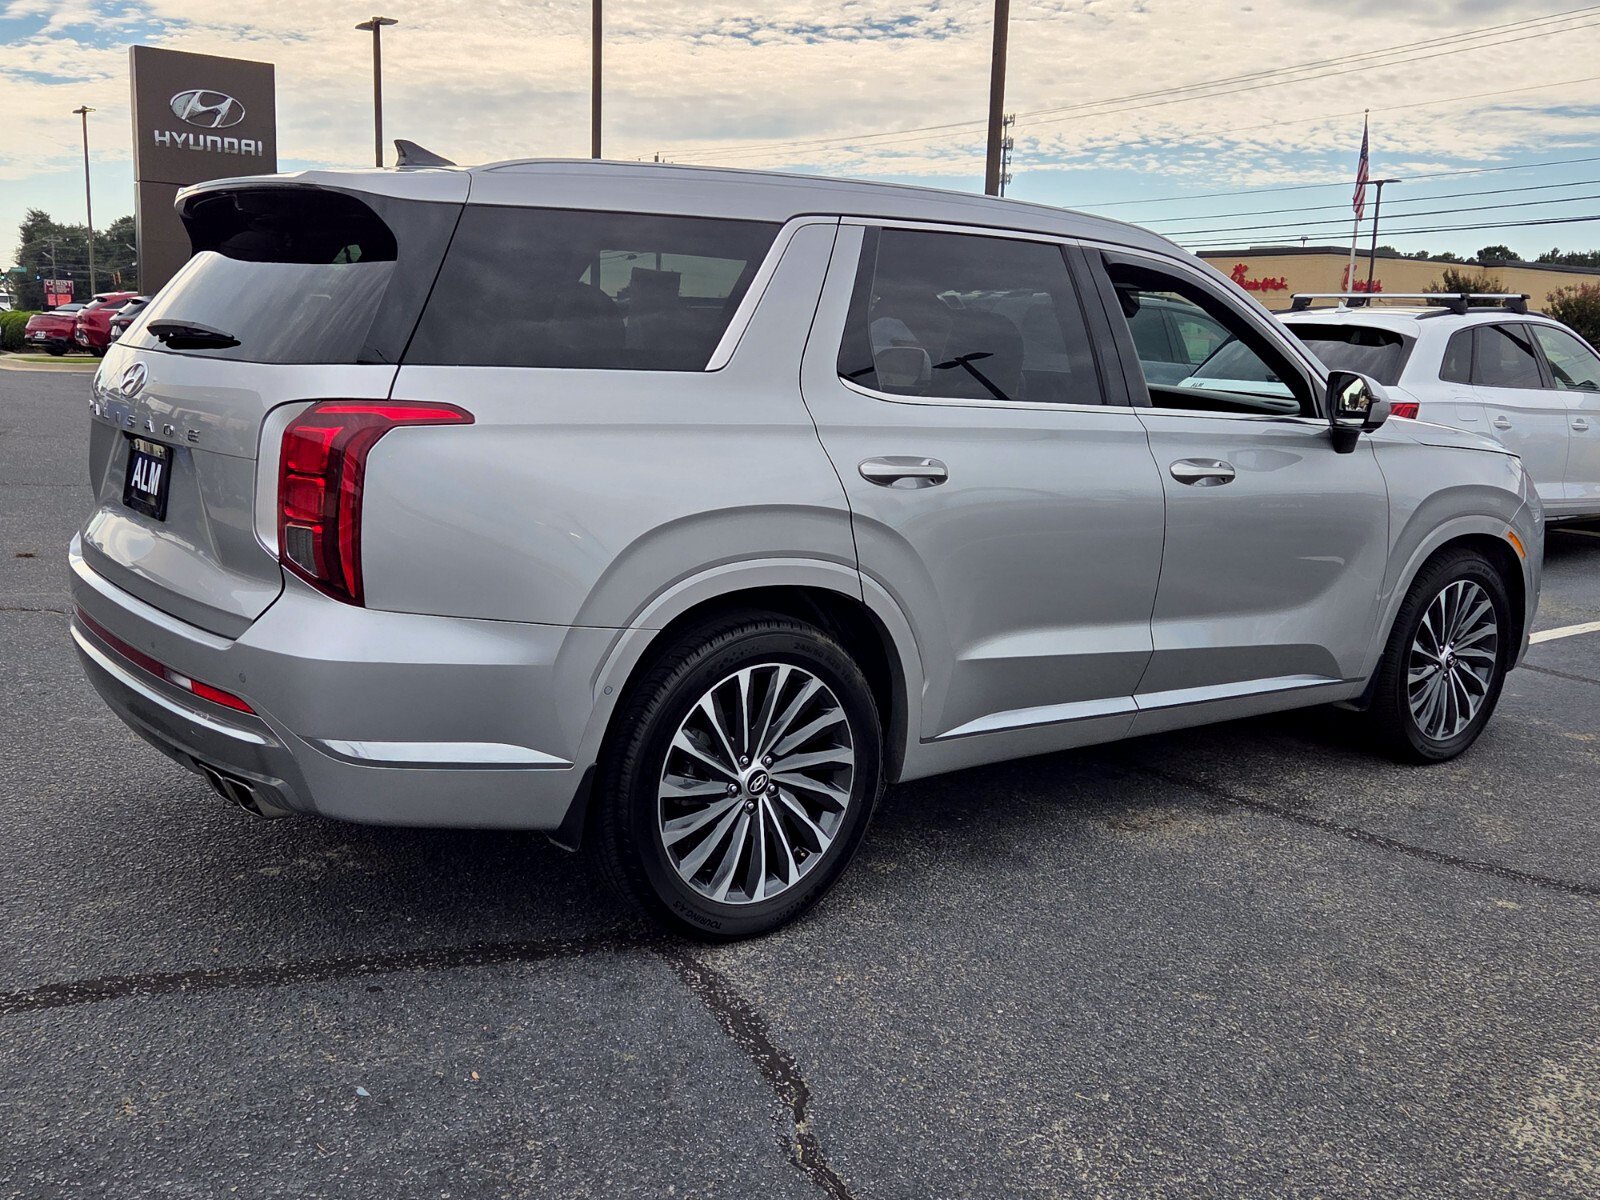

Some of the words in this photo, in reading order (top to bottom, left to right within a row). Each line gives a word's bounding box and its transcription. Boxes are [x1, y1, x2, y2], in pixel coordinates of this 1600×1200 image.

[153, 129, 263, 157] HYUNDAI
[131, 456, 163, 497] ALM
[686, 909, 722, 930] TOURING
